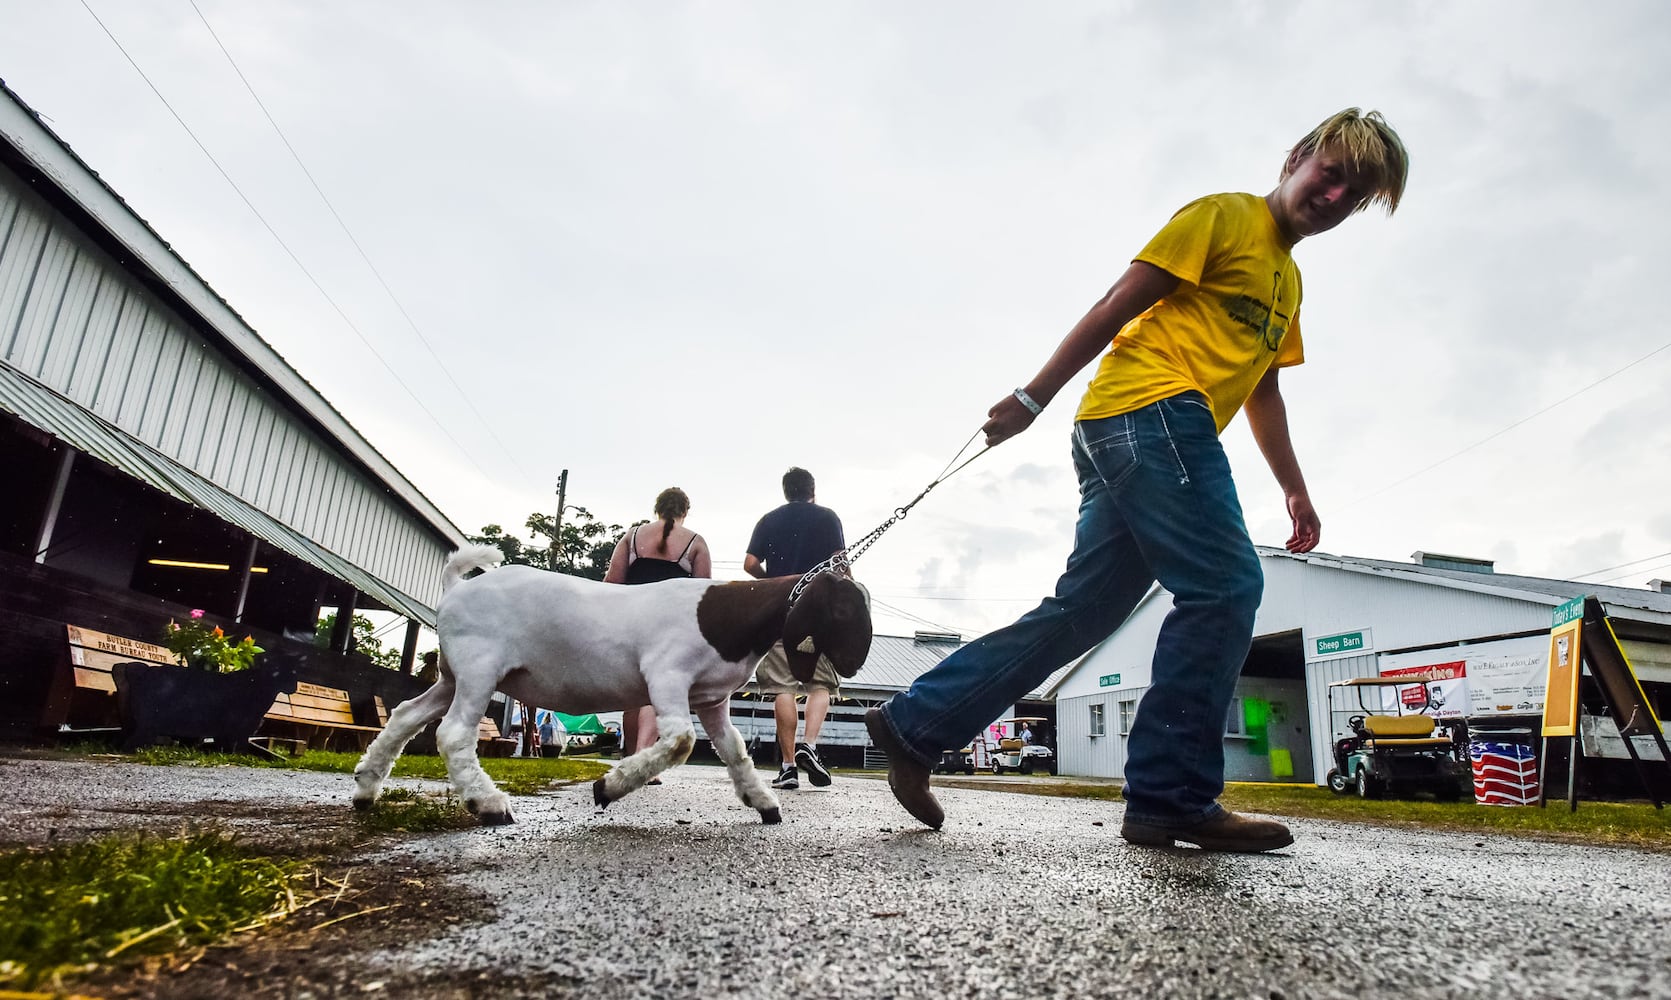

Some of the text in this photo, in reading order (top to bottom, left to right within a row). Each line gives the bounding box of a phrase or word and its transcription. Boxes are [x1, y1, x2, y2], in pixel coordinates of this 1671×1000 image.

[1553, 606, 1568, 625] Today's
[97, 641, 168, 663] FARM BUREAU YOUTH
[106, 634, 159, 653] BUTLER COUNTY
[1318, 637, 1360, 651] Sheep Barn
